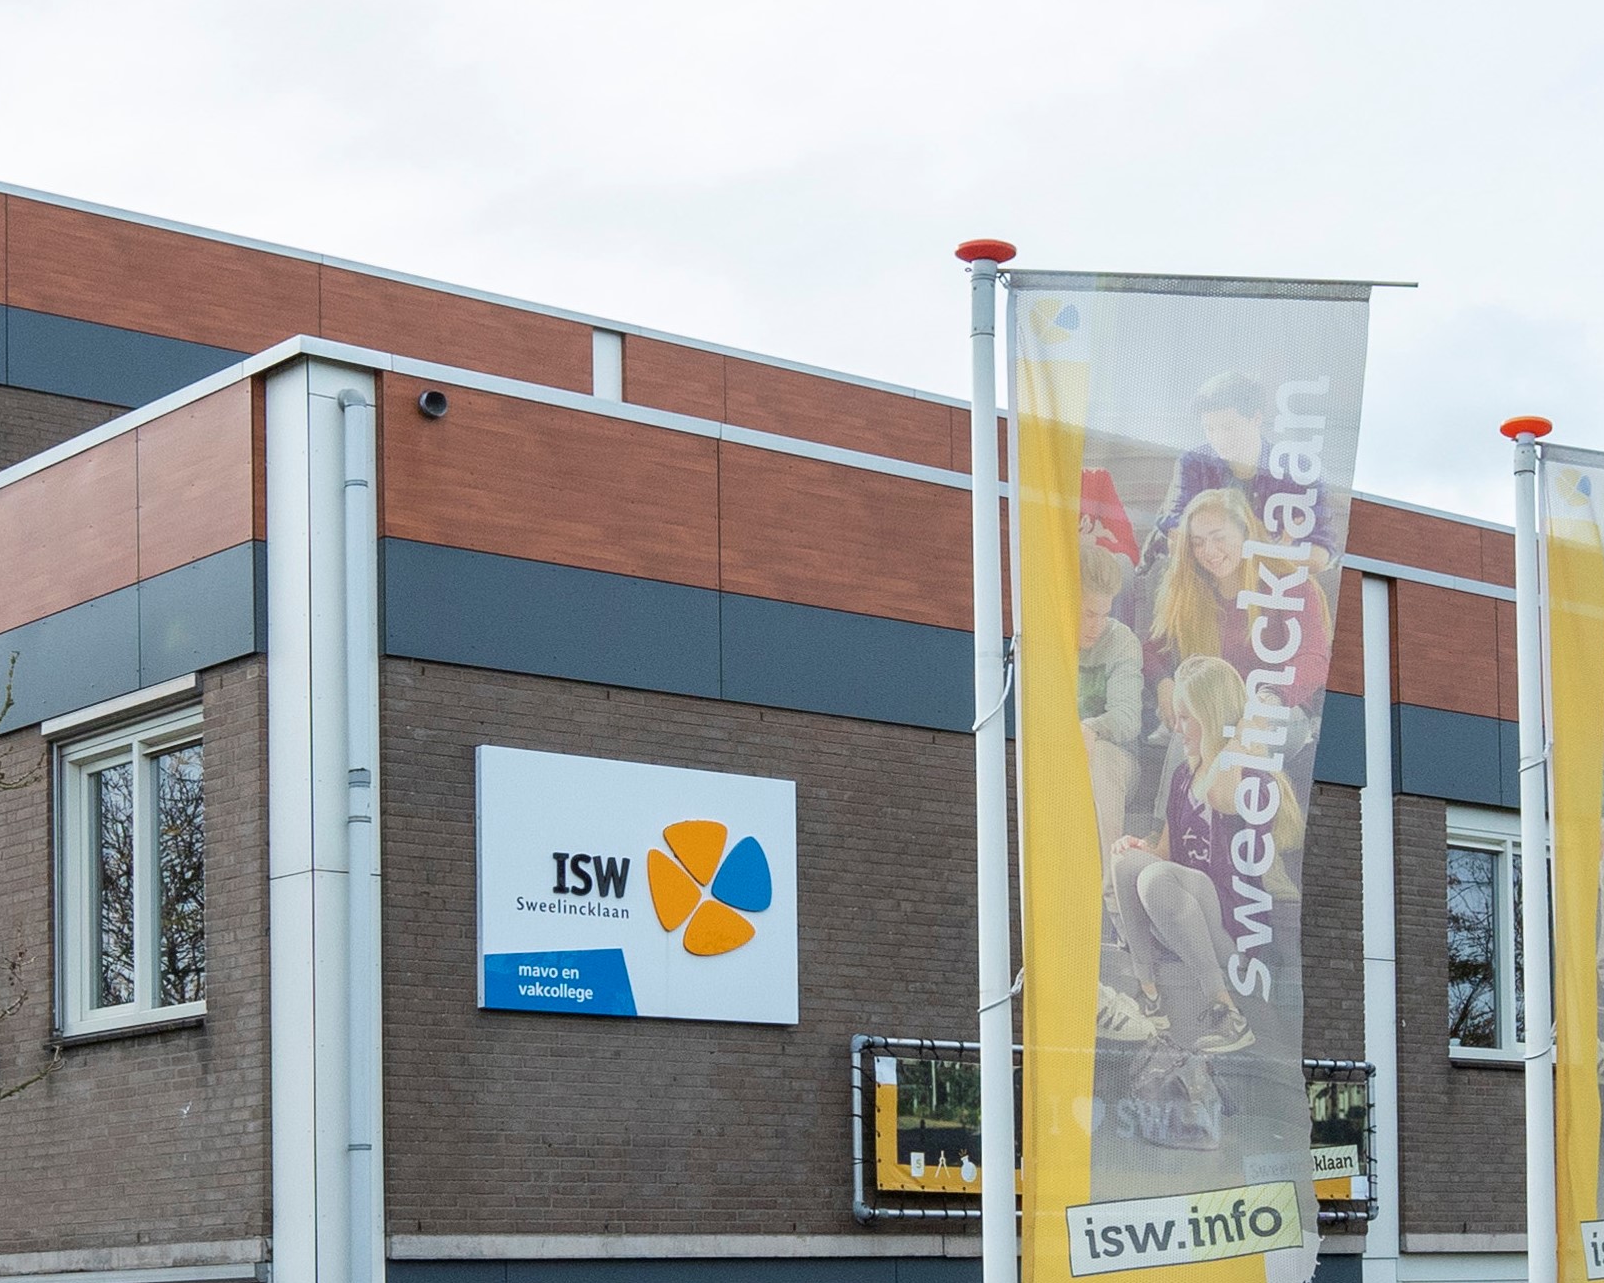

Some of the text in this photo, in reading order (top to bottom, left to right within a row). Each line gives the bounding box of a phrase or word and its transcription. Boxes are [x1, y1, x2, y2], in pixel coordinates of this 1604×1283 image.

[1219, 375, 1329, 1003] sweelincklaan
[552, 851, 631, 899] ISW
[516, 896, 630, 919] Sweelincklaan
[518, 965, 579, 980] mavo en
[518, 982, 593, 1003] vakcollege
[1084, 1199, 1283, 1259] isw.info
